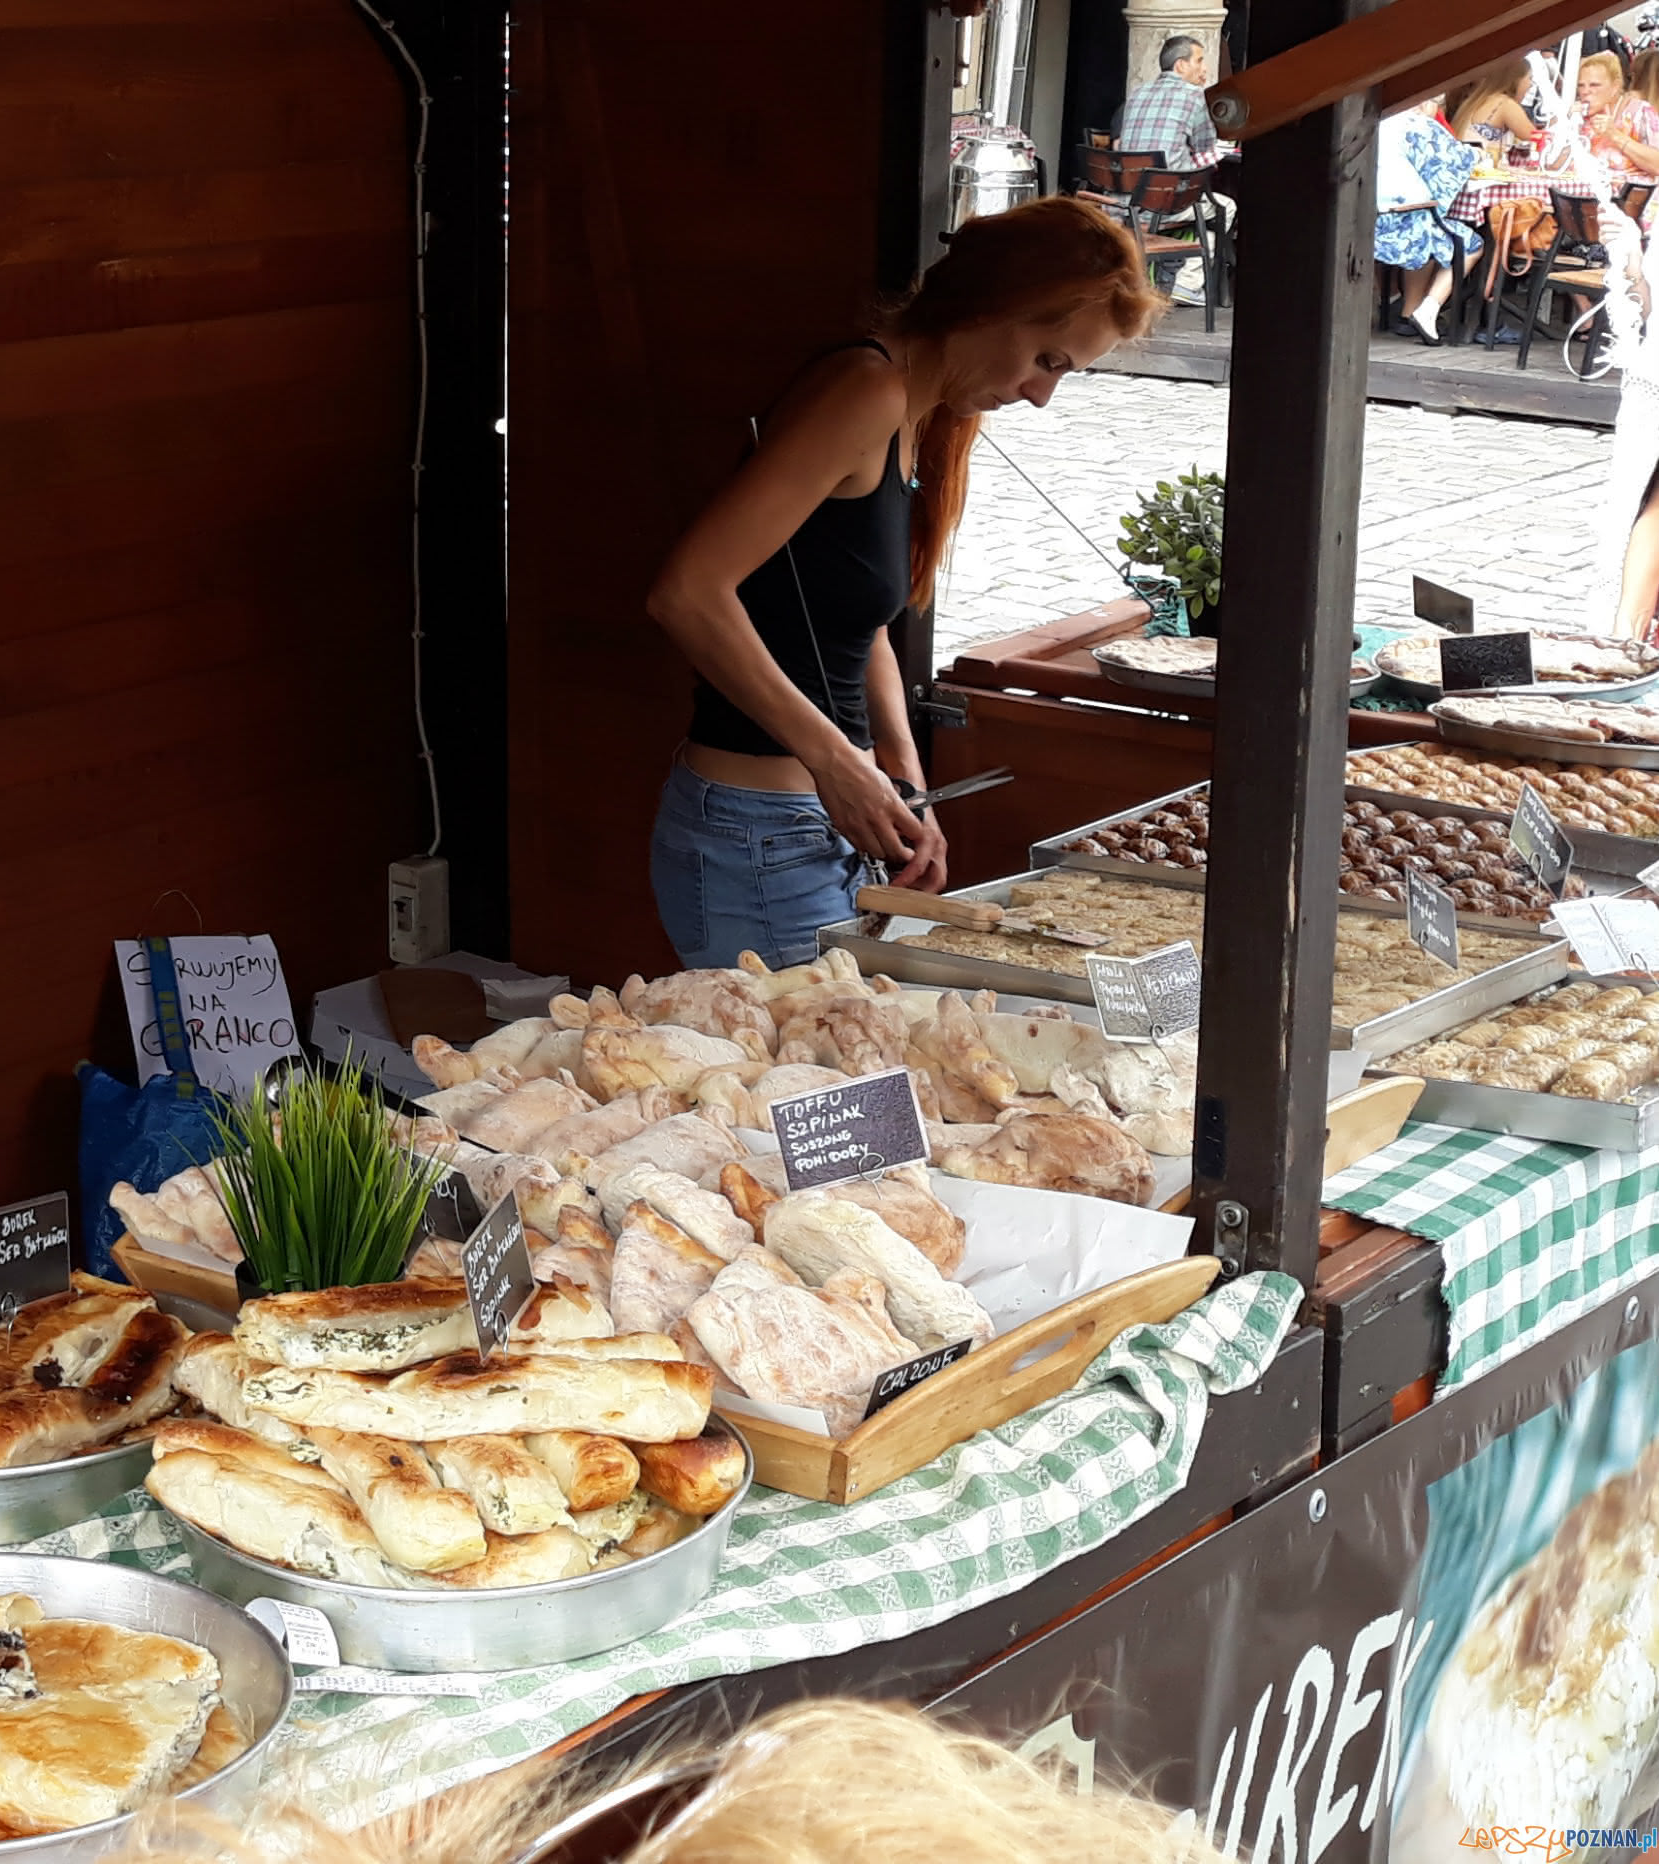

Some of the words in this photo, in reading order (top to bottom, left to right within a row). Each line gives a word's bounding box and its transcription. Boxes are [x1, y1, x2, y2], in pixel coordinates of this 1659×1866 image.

[127, 951, 276, 996] SRWUJEMY
[189, 993, 227, 1012] NA
[778, 1091, 842, 1122] TOFFU
